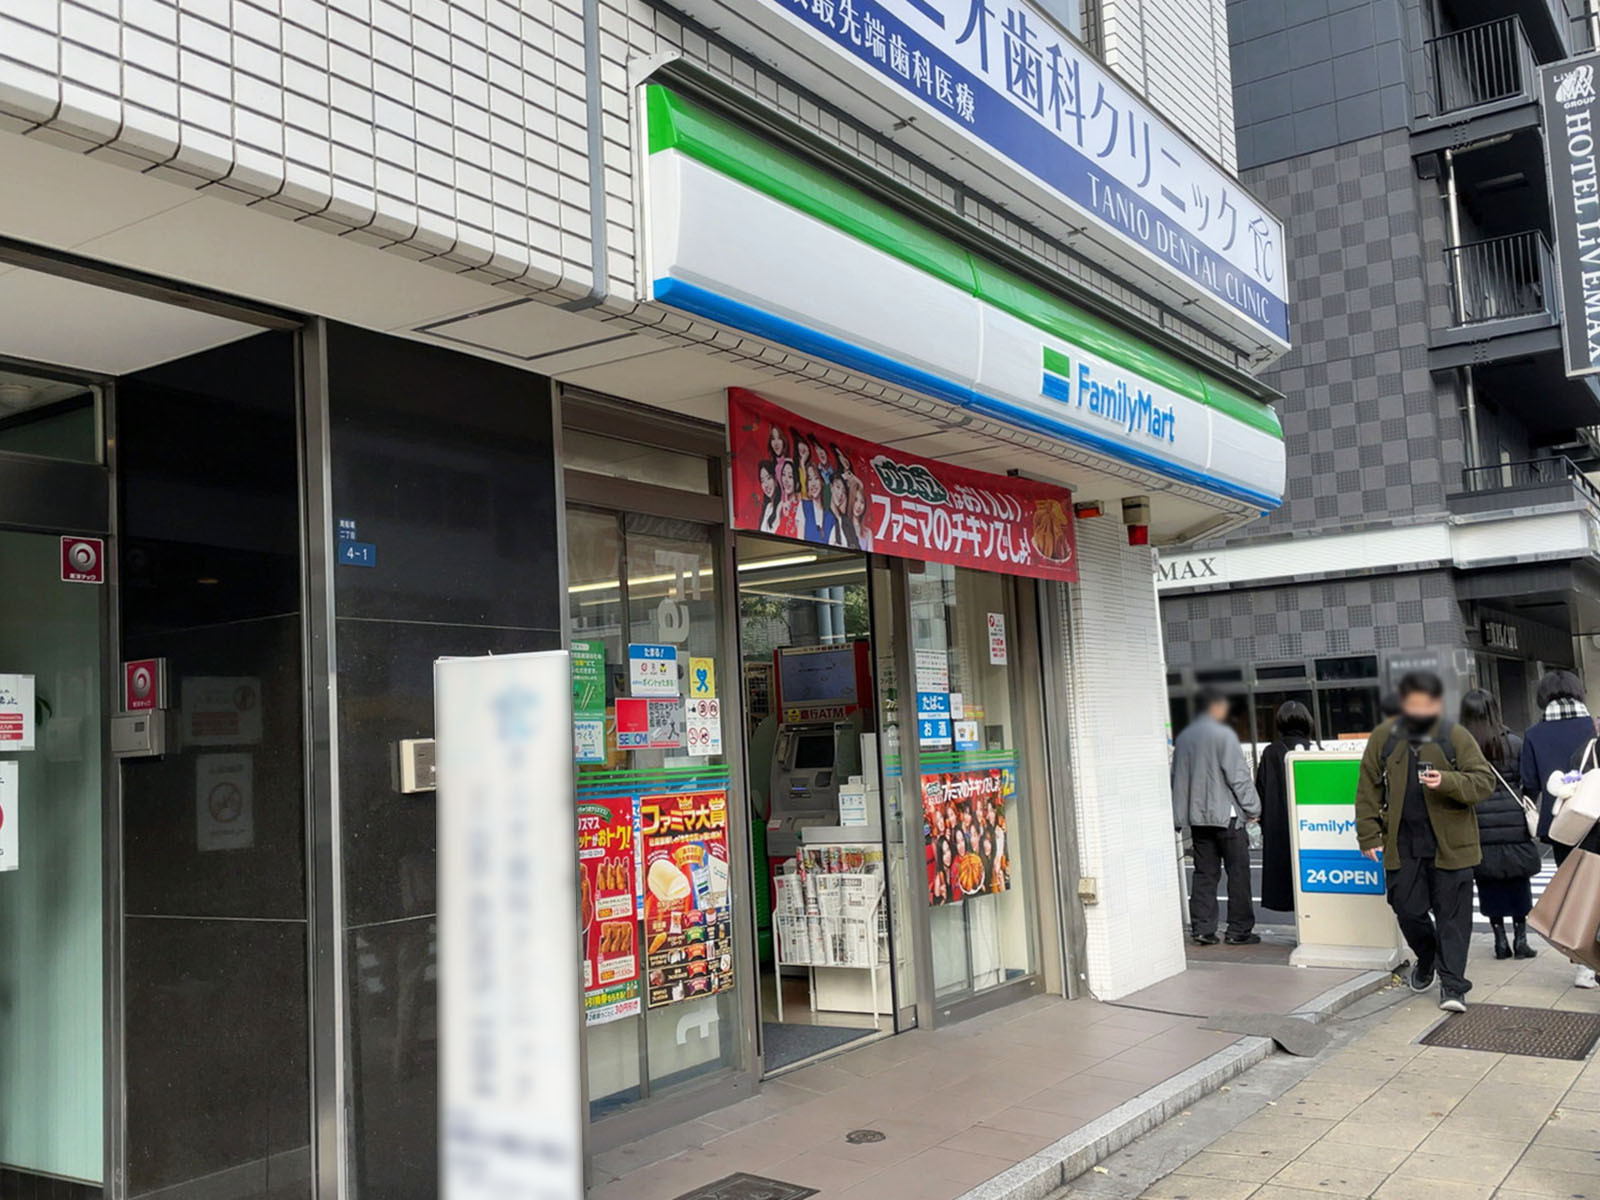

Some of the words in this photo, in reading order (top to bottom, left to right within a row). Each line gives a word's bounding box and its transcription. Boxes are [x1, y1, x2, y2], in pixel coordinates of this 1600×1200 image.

[795, 0, 976, 125] 最先端歯科医療
[1563, 96, 1596, 109] GROUP
[1565, 108, 1599, 214] HOTEL
[1087, 172, 1151, 241] TANIO
[1156, 219, 1222, 297] DENTAL
[1225, 272, 1270, 324] CLINIC
[1077, 361, 1176, 444] FamilyMart
[872, 463, 946, 501] クリスマス
[870, 493, 1032, 566] ファミマのチキンでしょ!
[346, 546, 368, 561] 4-1
[1157, 556, 1218, 582] MAX
[921, 695, 945, 711] たばこ
[619, 733, 648, 745] SECOM
[640, 797, 727, 835] ファミマ大賞
[1299, 818, 1357, 835] FamilyM
[1306, 869, 1328, 884] 24
[1328, 869, 1378, 886] OPEN
